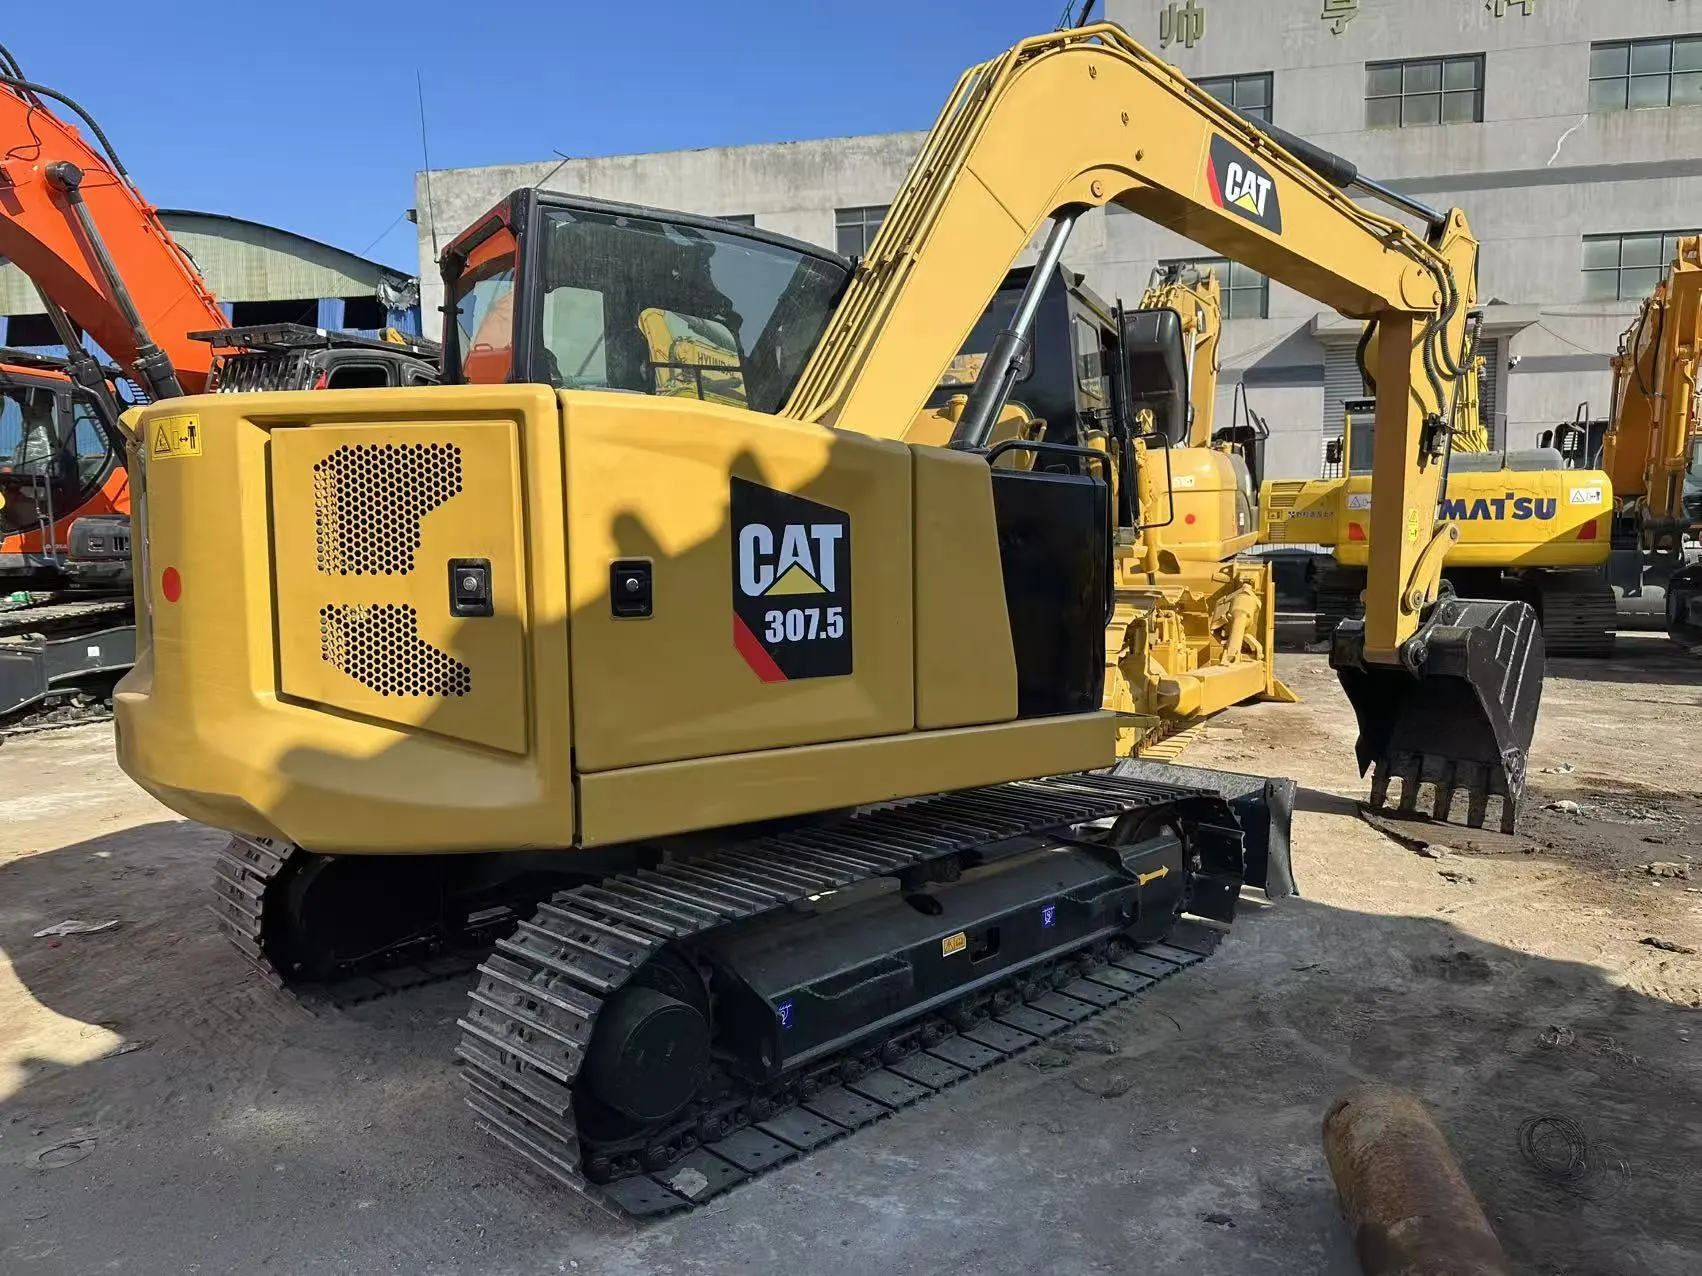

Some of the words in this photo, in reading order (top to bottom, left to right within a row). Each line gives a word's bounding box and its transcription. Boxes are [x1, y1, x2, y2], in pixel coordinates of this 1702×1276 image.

[1224, 161, 1272, 217] CAT
[1438, 492, 1557, 521] MATSU
[739, 523, 843, 597] CAT
[765, 606, 844, 644] 307.5
